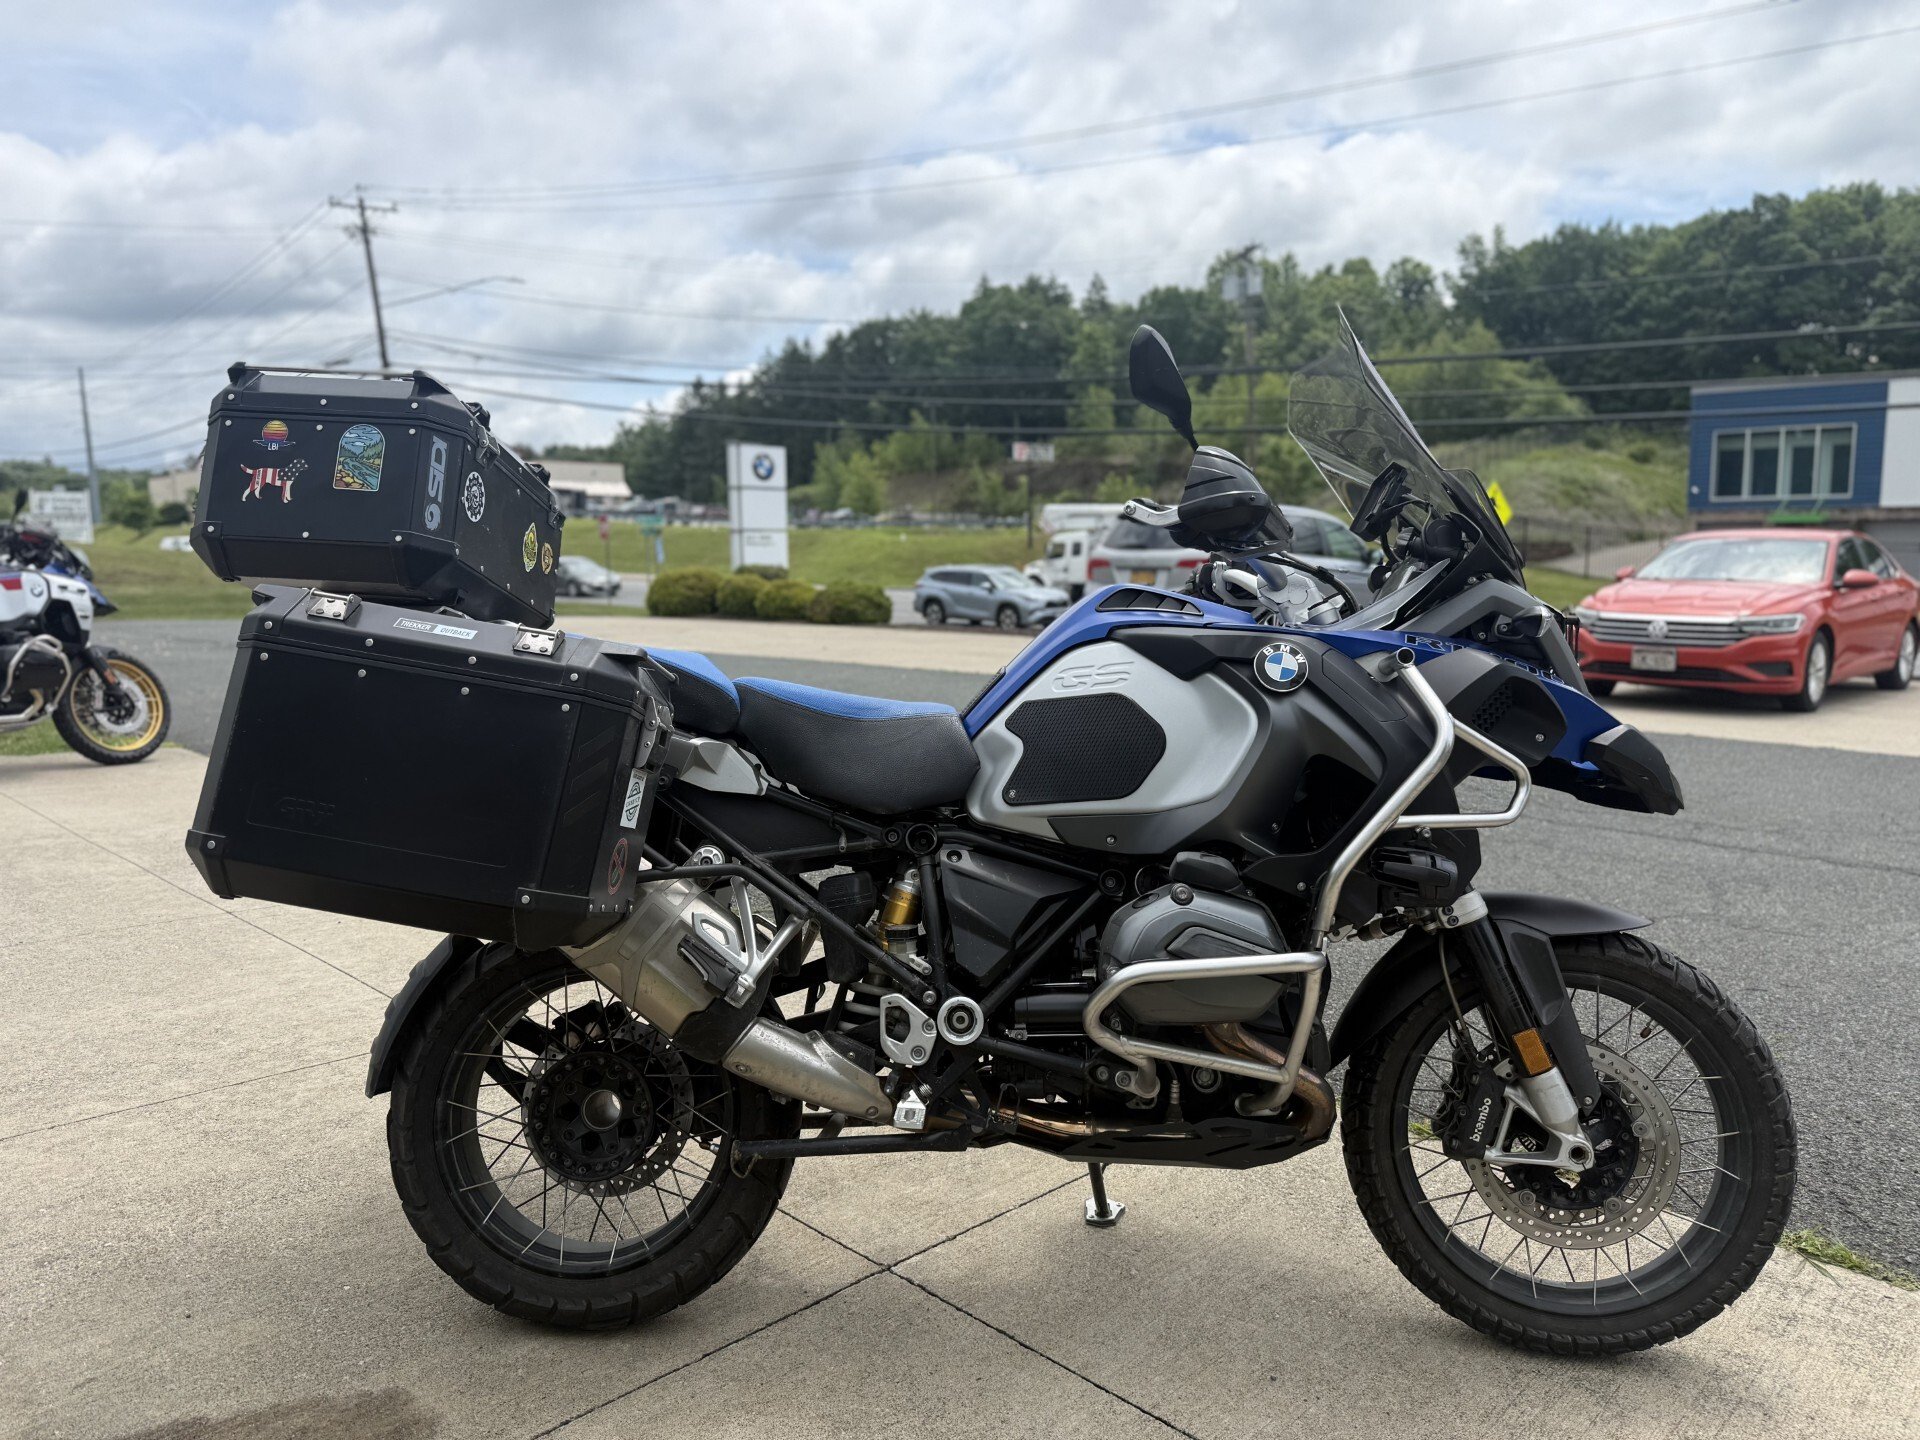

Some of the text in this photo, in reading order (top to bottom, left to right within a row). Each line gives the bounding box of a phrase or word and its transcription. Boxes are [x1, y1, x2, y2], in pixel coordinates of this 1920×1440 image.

[267, 443, 279, 451] LBI
[400, 620, 472, 637] TREKKER OUTBACK
[1262, 644, 1306, 663] BMW
[1051, 661, 1135, 693] GS
[1469, 1097, 1492, 1143] brembo
